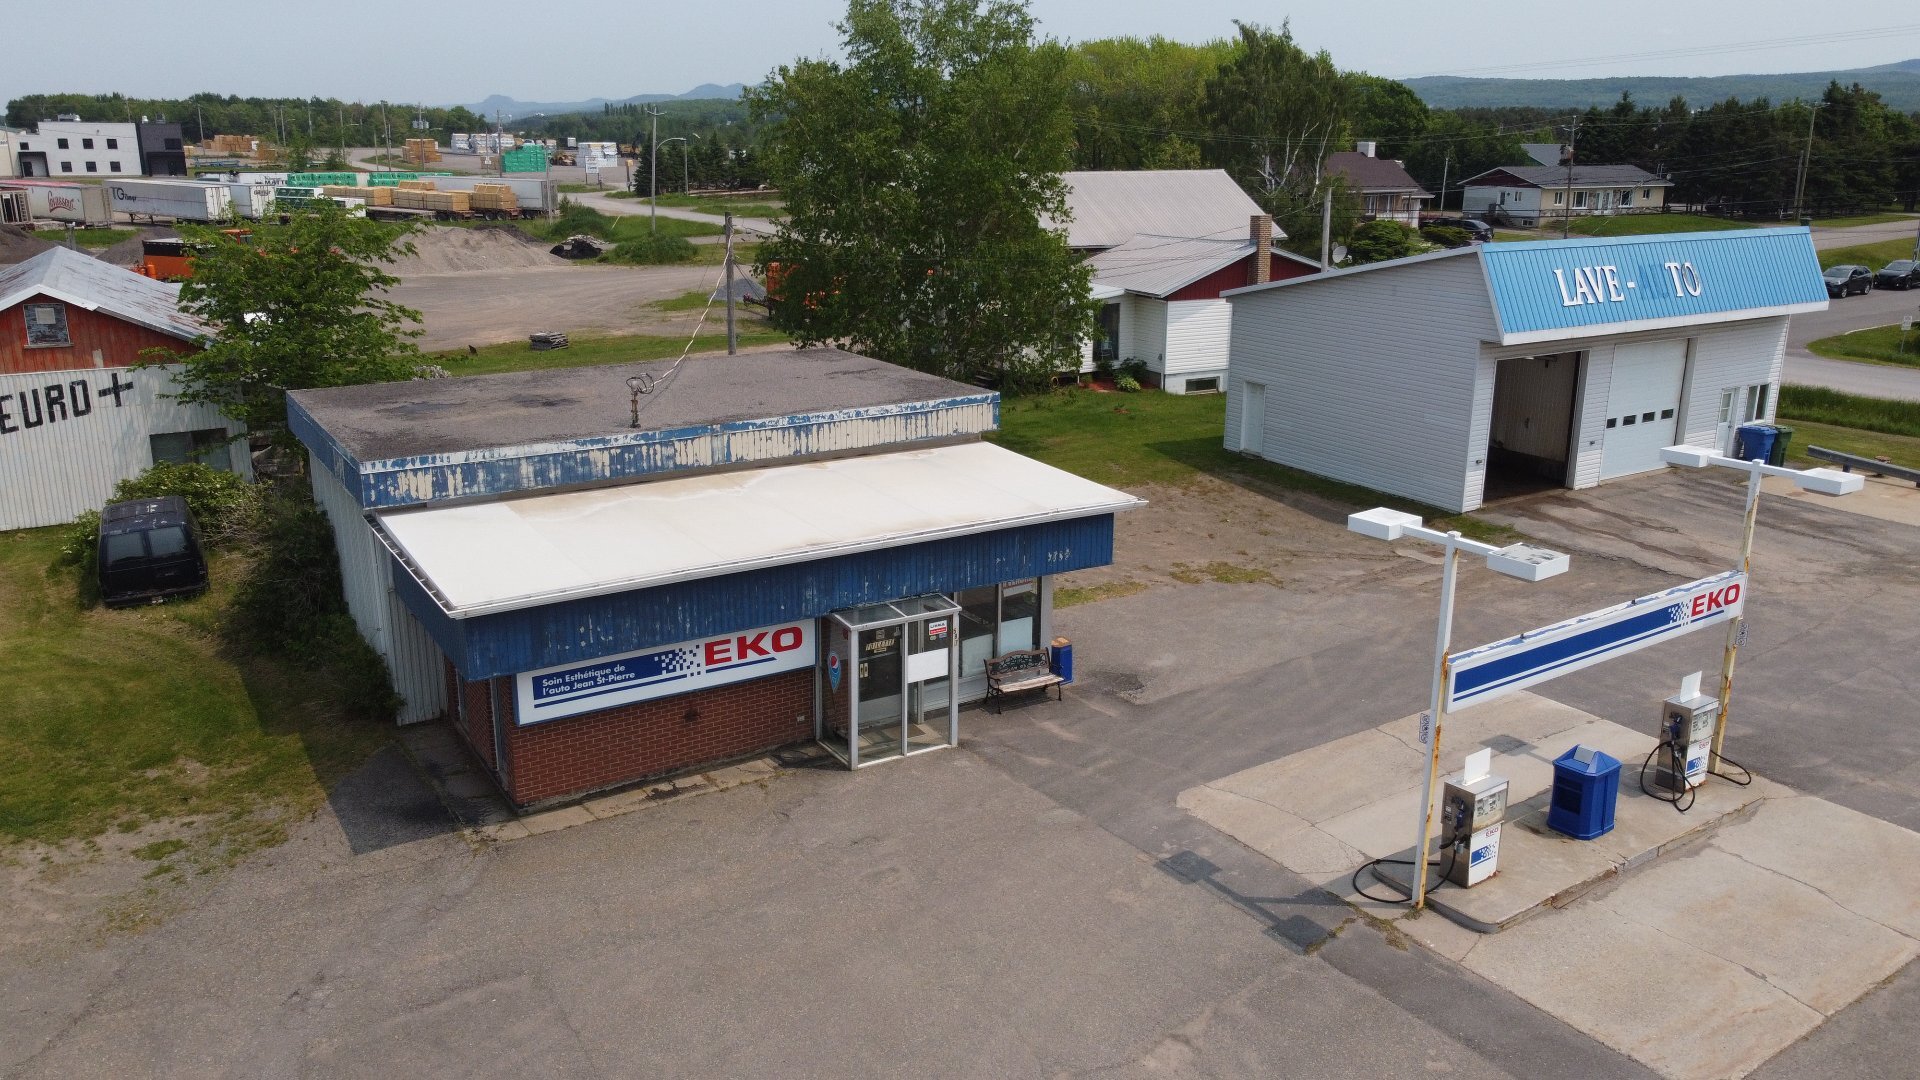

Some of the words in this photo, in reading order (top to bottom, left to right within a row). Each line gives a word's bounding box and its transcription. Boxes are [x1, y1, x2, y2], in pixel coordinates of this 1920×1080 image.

[1691, 583, 1741, 617] EKO
[704, 626, 803, 667] EKO
[542, 677, 563, 687] Soin
[565, 667, 612, 682] Esthétique
[614, 663, 626, 673] de
[573, 680, 595, 690] Jean
[596, 672, 635, 685] St-Pierre
